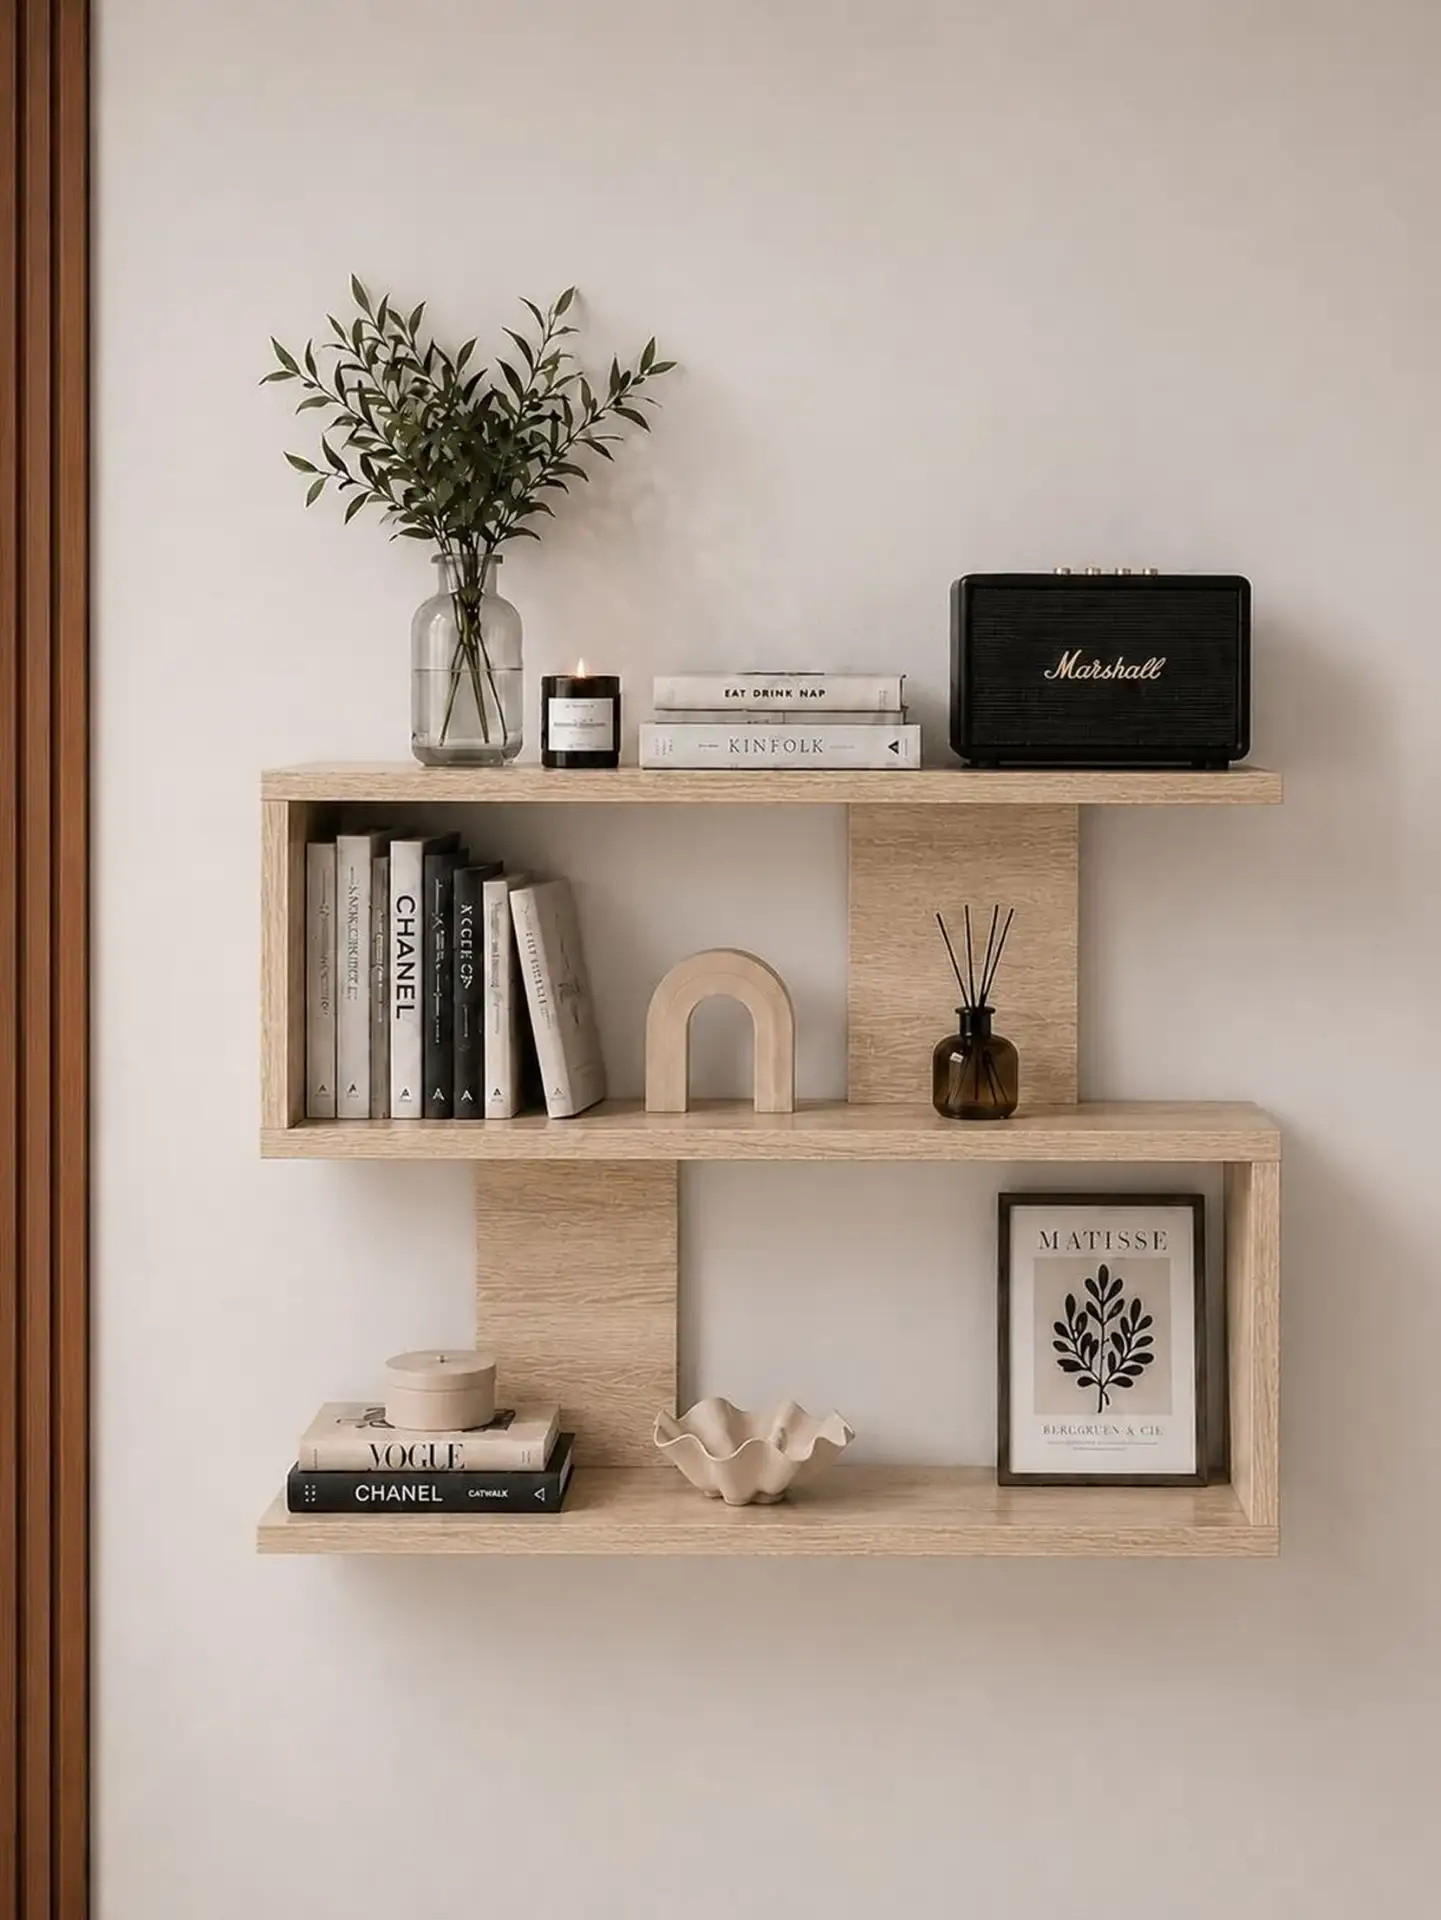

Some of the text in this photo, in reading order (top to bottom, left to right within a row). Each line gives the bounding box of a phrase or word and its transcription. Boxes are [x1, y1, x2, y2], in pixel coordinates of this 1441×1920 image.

[1044, 649, 1167, 680] Marshall
[724, 689, 826, 698] EAT DRINK NAP
[729, 738, 824, 753] KINFOLK
[396, 894, 416, 1020] CHANEL
[1039, 1230, 1168, 1251] MATISSE
[369, 1443, 465, 1470] VOGUE
[355, 1484, 508, 1502] CHANEL CATWALK
